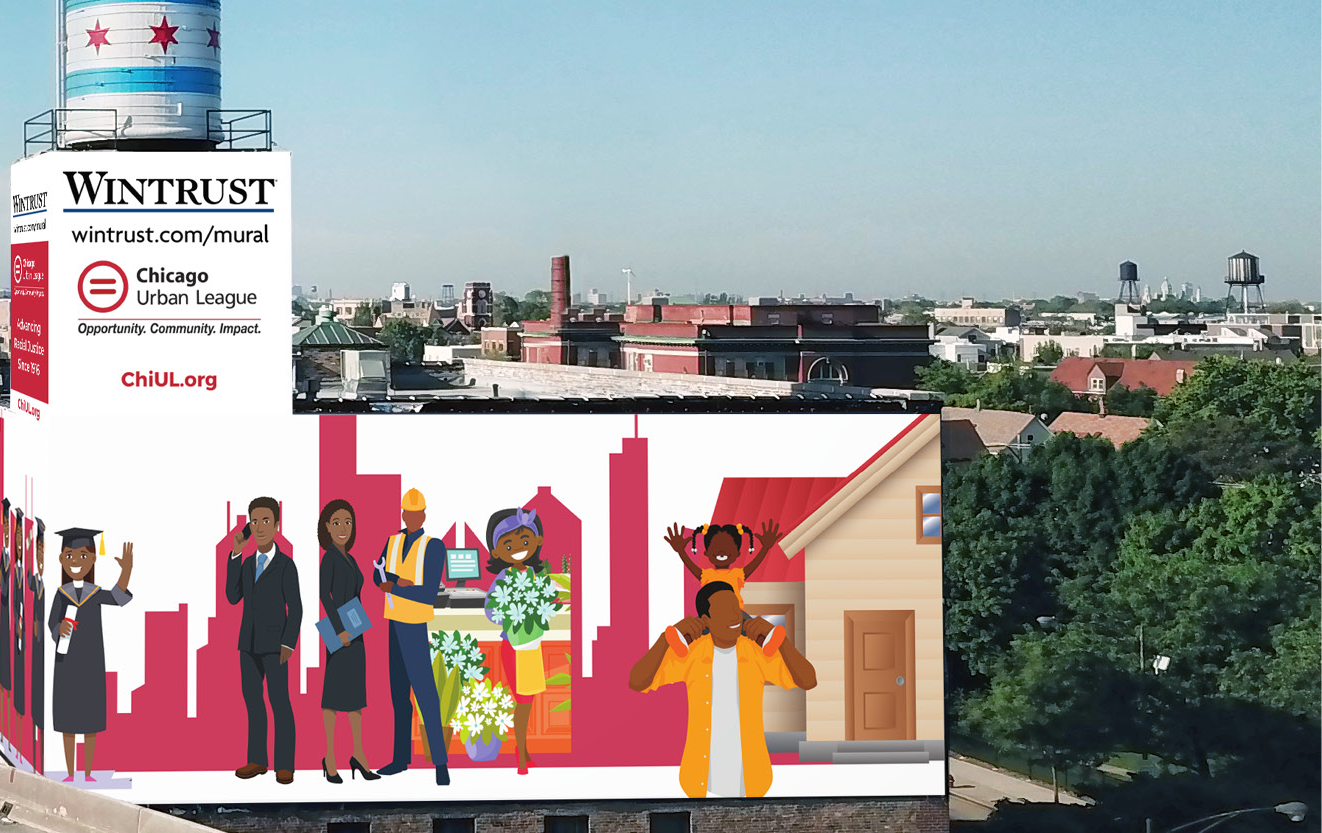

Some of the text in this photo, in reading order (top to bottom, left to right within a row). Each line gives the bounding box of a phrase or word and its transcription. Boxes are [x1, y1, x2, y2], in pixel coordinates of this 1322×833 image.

[62, 171, 275, 205] WINTRUST
[71, 224, 269, 246] wintrust.com/mural
[136, 267, 208, 286] Chicago
[137, 289, 257, 309] Urban League
[78, 322, 261, 336] Opportunity. Community. Impact.
[121, 370, 217, 391] ChiUL.org
